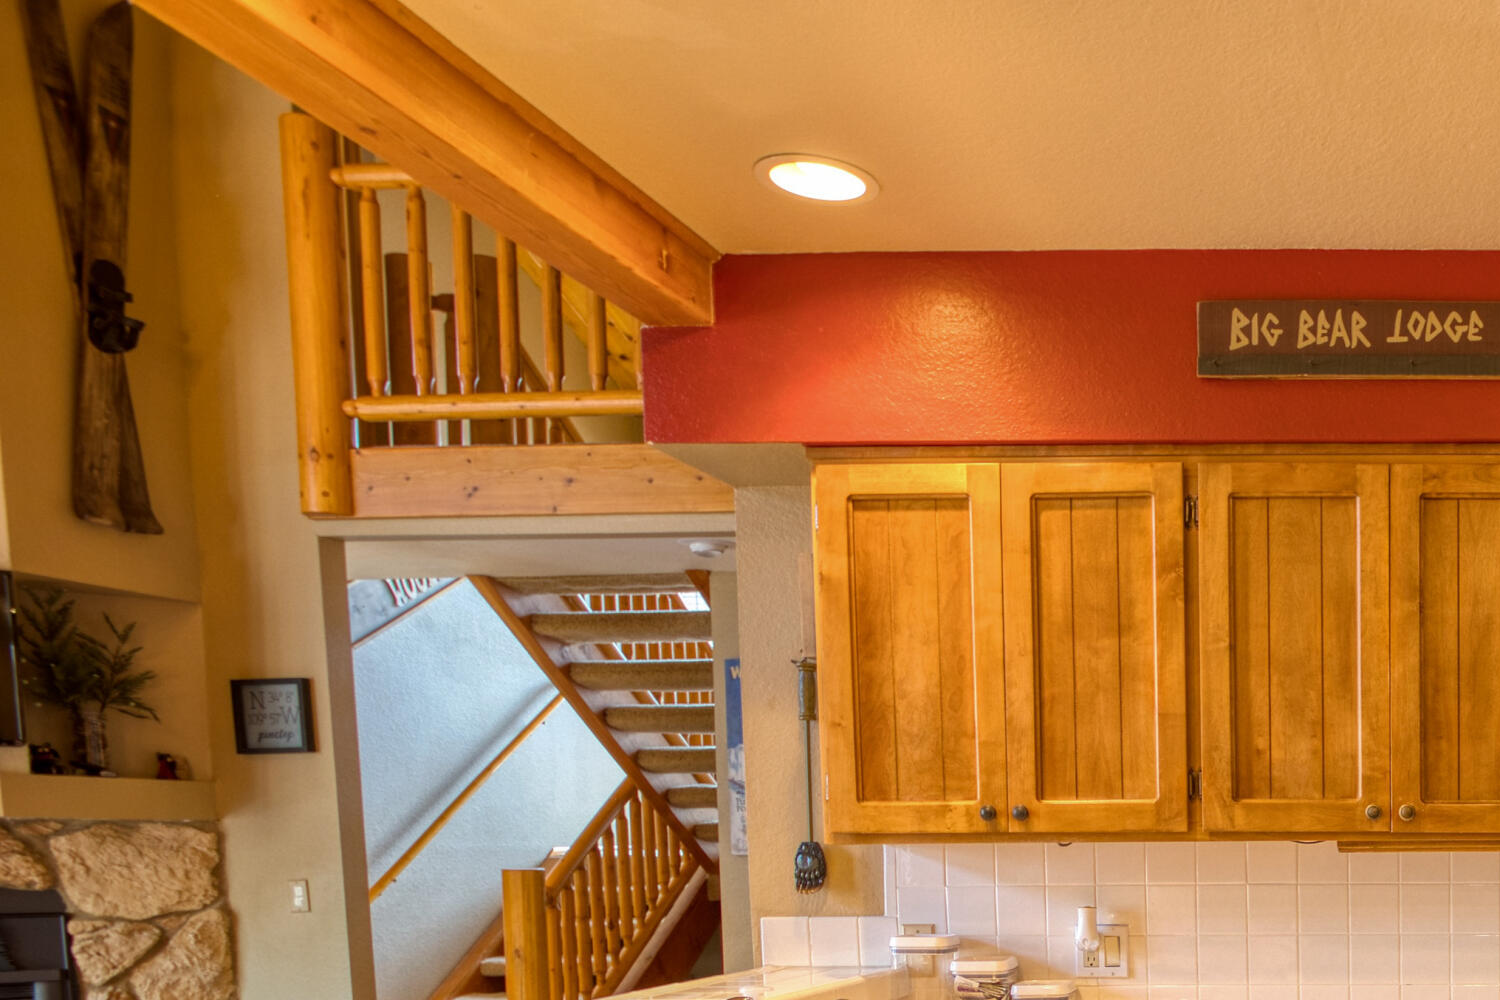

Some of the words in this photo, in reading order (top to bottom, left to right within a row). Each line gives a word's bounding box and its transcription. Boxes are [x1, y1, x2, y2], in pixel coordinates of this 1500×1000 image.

[1229, 308, 1283, 350] BIG
[1297, 308, 1371, 349] BEAR
[1386, 308, 1484, 343] LODGE
